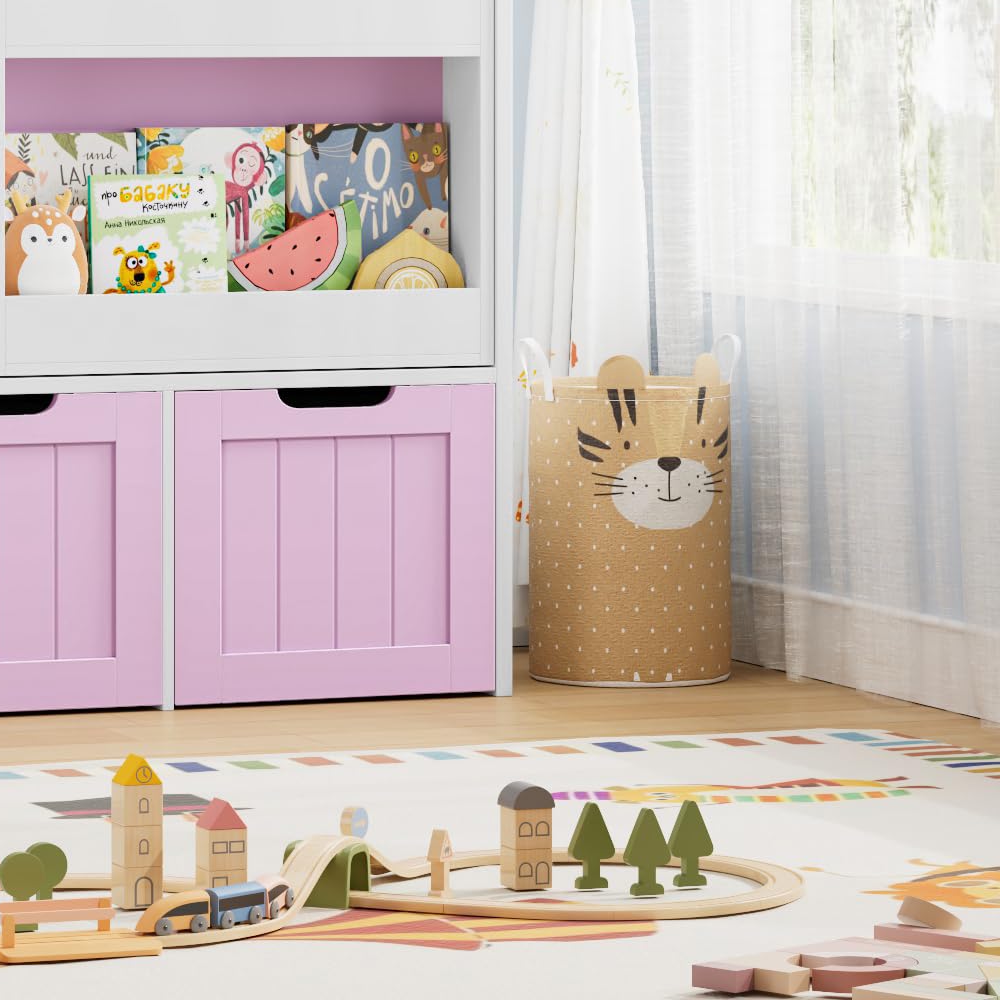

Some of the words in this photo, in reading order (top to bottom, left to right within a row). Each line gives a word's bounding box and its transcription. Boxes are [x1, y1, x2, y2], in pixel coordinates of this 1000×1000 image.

[85, 146, 118, 161] und
[364, 137, 391, 191] O
[101, 189, 118, 207] про
[104, 220, 123, 229] Анна
